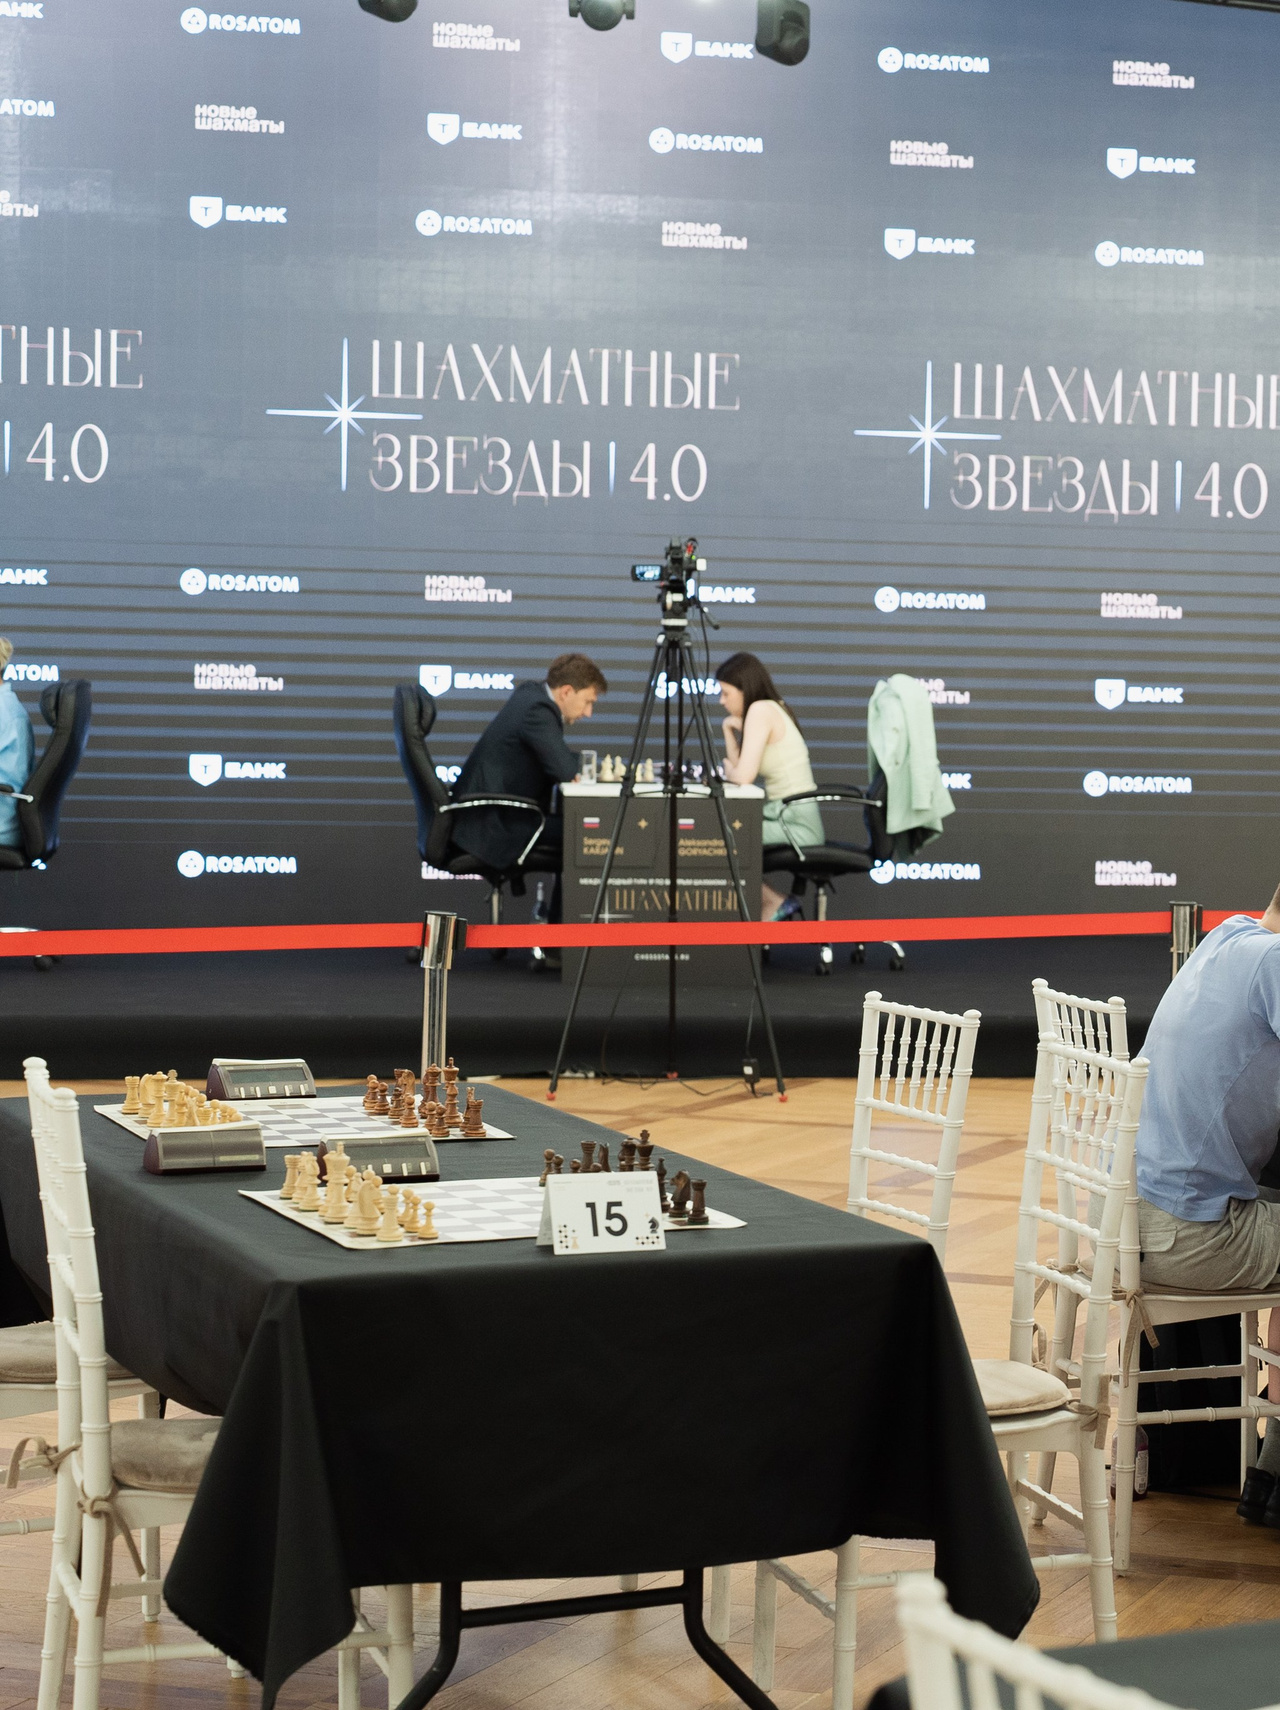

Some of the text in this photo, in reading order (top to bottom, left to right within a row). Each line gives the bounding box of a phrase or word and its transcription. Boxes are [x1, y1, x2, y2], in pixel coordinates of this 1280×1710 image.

[208, 13, 301, 35] ROSATOM
[694, 41, 754, 59] БАНК
[903, 52, 990, 74] ROSATOM
[462, 121, 522, 140] БАНК
[675, 133, 764, 154] ROSATOM
[1138, 156, 1196, 175] БАНК
[225, 204, 288, 224] БАНК
[443, 215, 533, 236] ROSATOM
[917, 236, 975, 255] БАНК
[1120, 246, 1205, 266] ROSATOM
[370, 338, 742, 411] ШАХМАТНЫЕ
[25, 421, 110, 485] 4.0
[367, 432, 709, 506] ЗВЕЗДЫ 4.0
[949, 450, 1270, 524] ЗВЕЗДЫ 4.0
[207, 573, 300, 593] ROSATOM
[698, 585, 756, 604] БАНК
[900, 591, 986, 610] ROSATOM
[453, 672, 515, 690] БАНК
[1126, 686, 1184, 704] БАНК
[224, 761, 287, 780] БАНК
[1108, 775, 1193, 794] ROSATOM
[205, 855, 297, 874] ROSATOM
[895, 862, 981, 881] ROSATOM
[585, 1201, 628, 1237] 15
